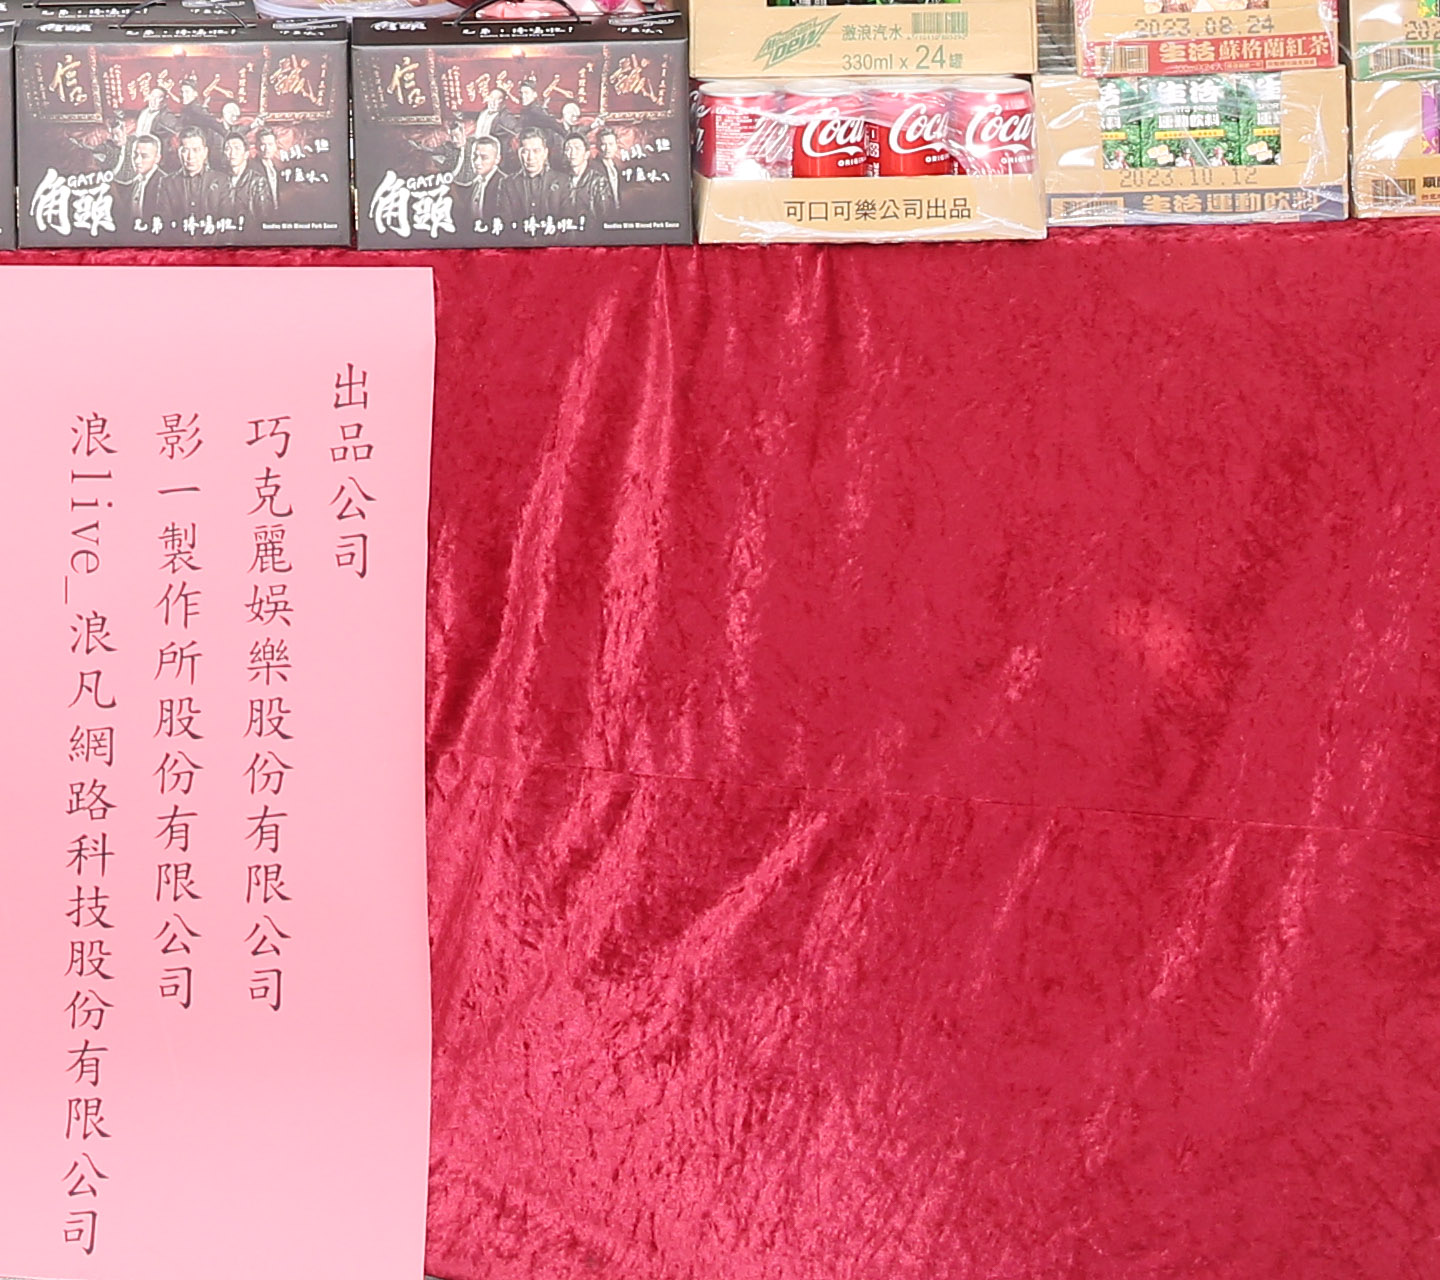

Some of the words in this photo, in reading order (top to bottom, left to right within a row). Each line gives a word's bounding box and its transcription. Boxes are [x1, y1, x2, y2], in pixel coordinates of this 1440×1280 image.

[841, 24, 902, 41] 激浪汽水
[842, 54, 893, 71] 330ml
[369, 170, 456, 238] 角頭
[406, 173, 453, 190] GATAO
[784, 198, 972, 222] 可口可樂公司出品
[330, 363, 376, 579] 出品公司
[153, 413, 204, 1009] 影一製作所股份有限公司
[243, 416, 294, 1011] 巧克麗娛樂股份有限公司
